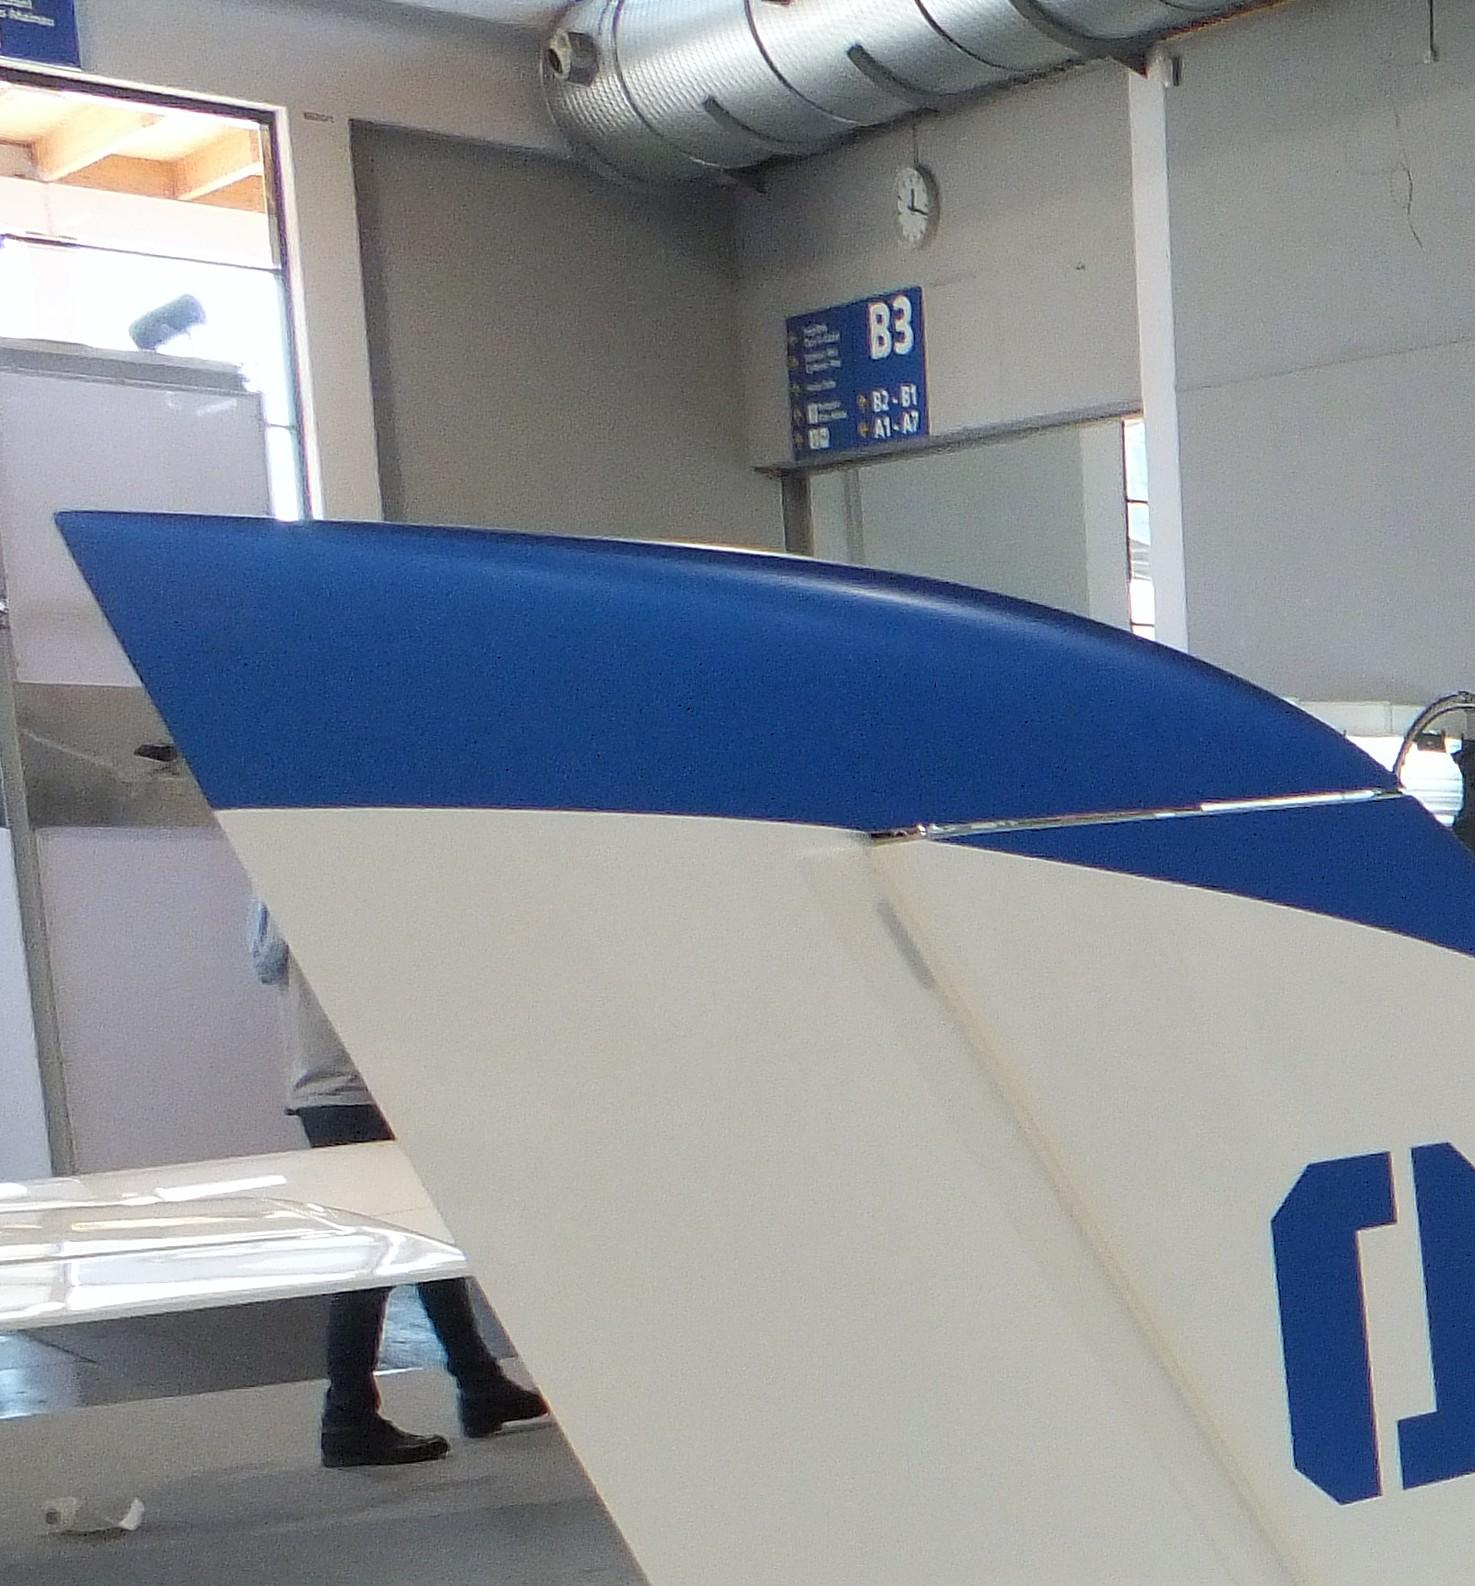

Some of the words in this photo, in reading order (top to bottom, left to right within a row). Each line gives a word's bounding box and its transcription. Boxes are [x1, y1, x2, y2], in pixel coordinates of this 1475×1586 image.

[868, 295, 914, 360] B3
[871, 389, 890, 413] B2
[901, 384, 918, 407] B1
[873, 416, 891, 439] A1
